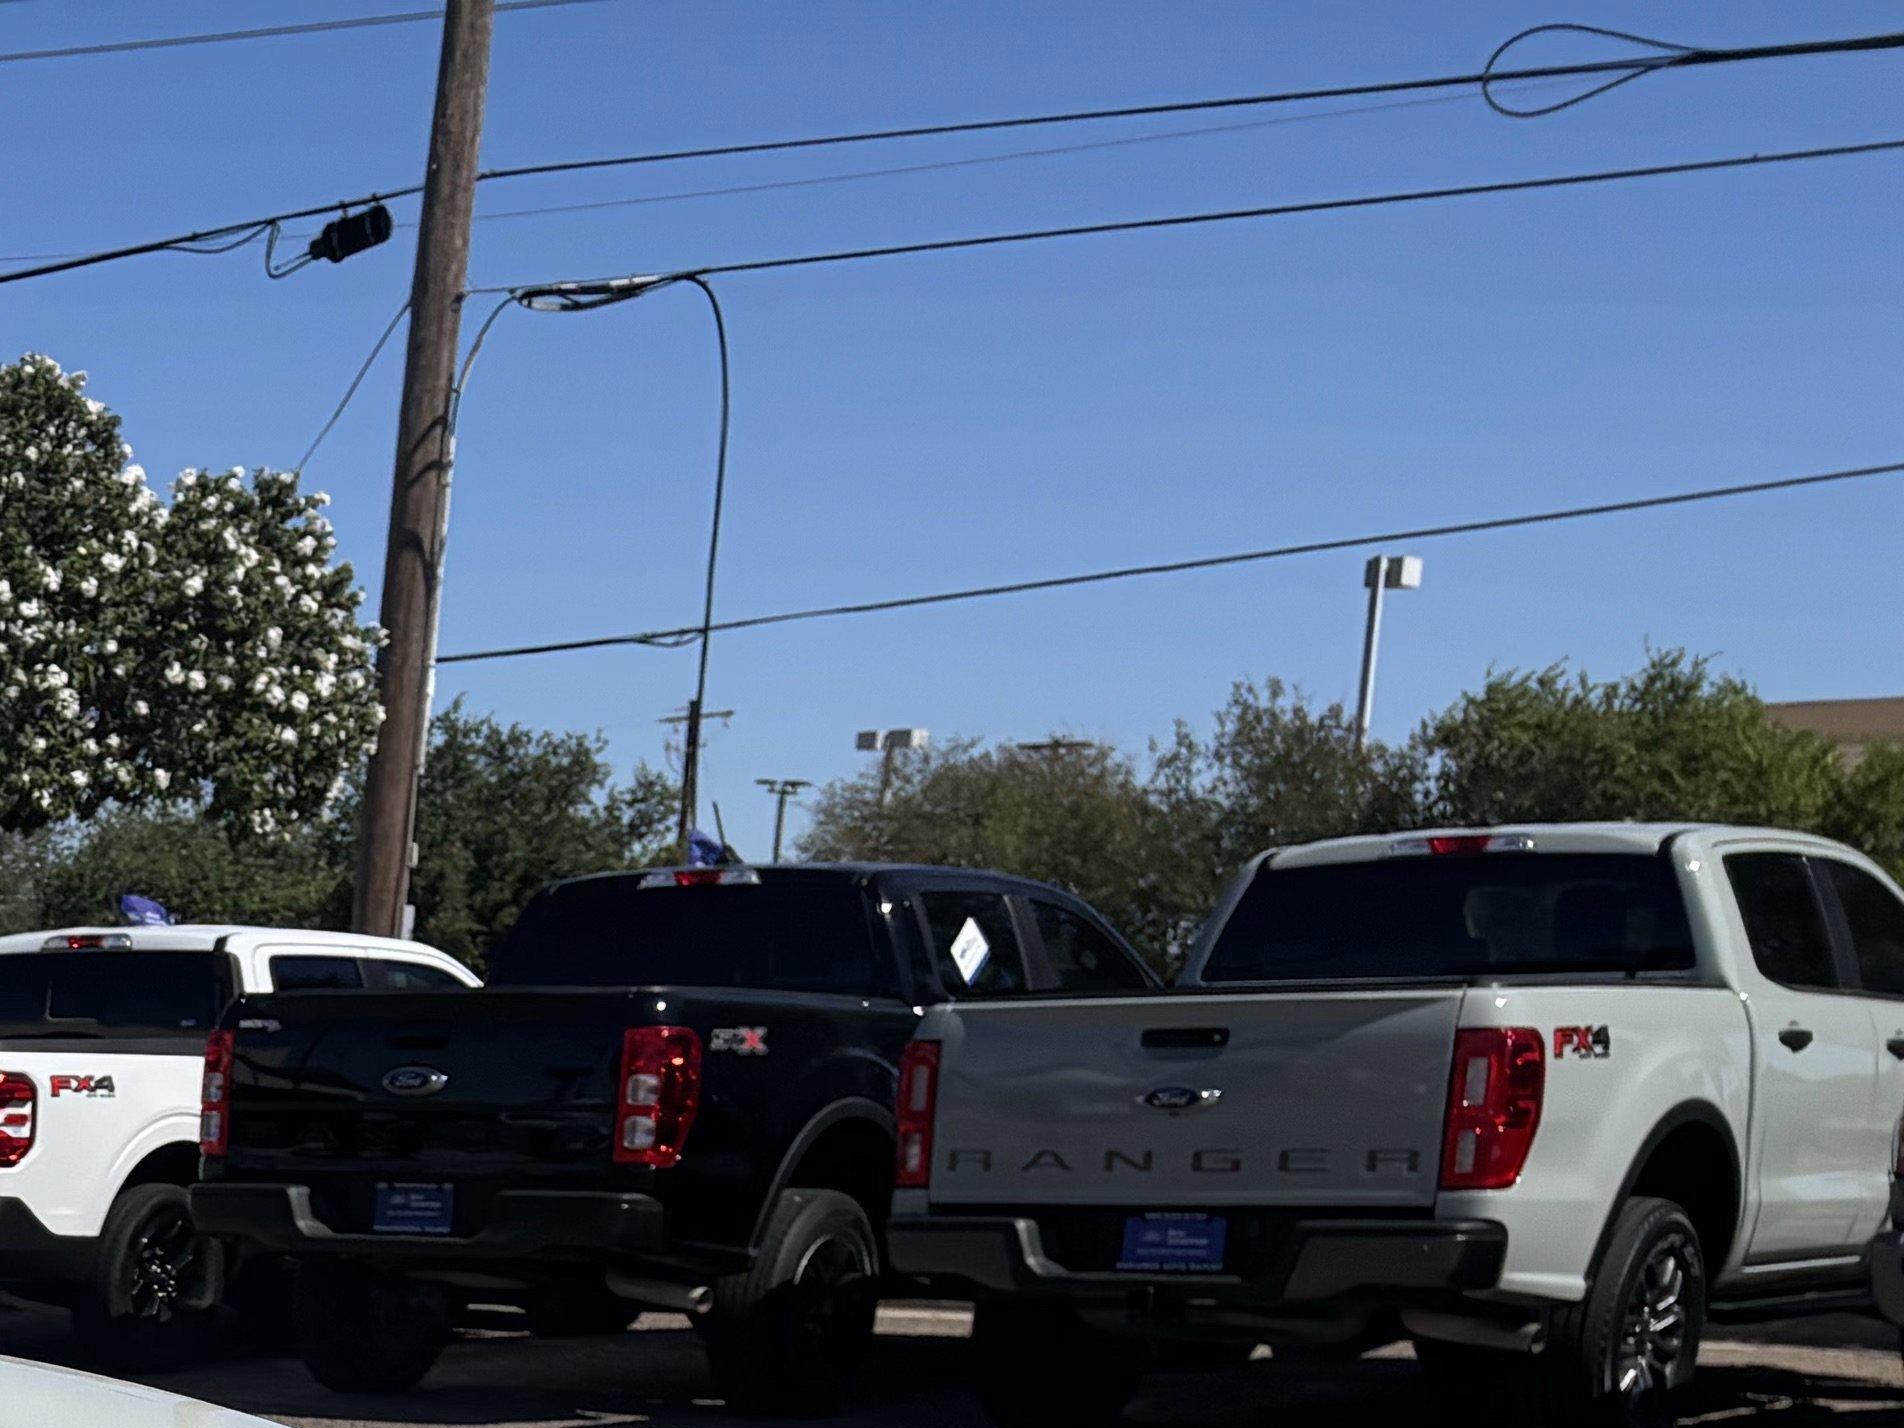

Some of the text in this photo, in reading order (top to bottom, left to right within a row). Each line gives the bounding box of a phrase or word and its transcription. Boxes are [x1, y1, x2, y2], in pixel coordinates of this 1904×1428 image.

[1553, 1024, 1611, 1059] FX4
[49, 1074, 115, 1097] FX4
[945, 1147, 1421, 1174] RANGER
